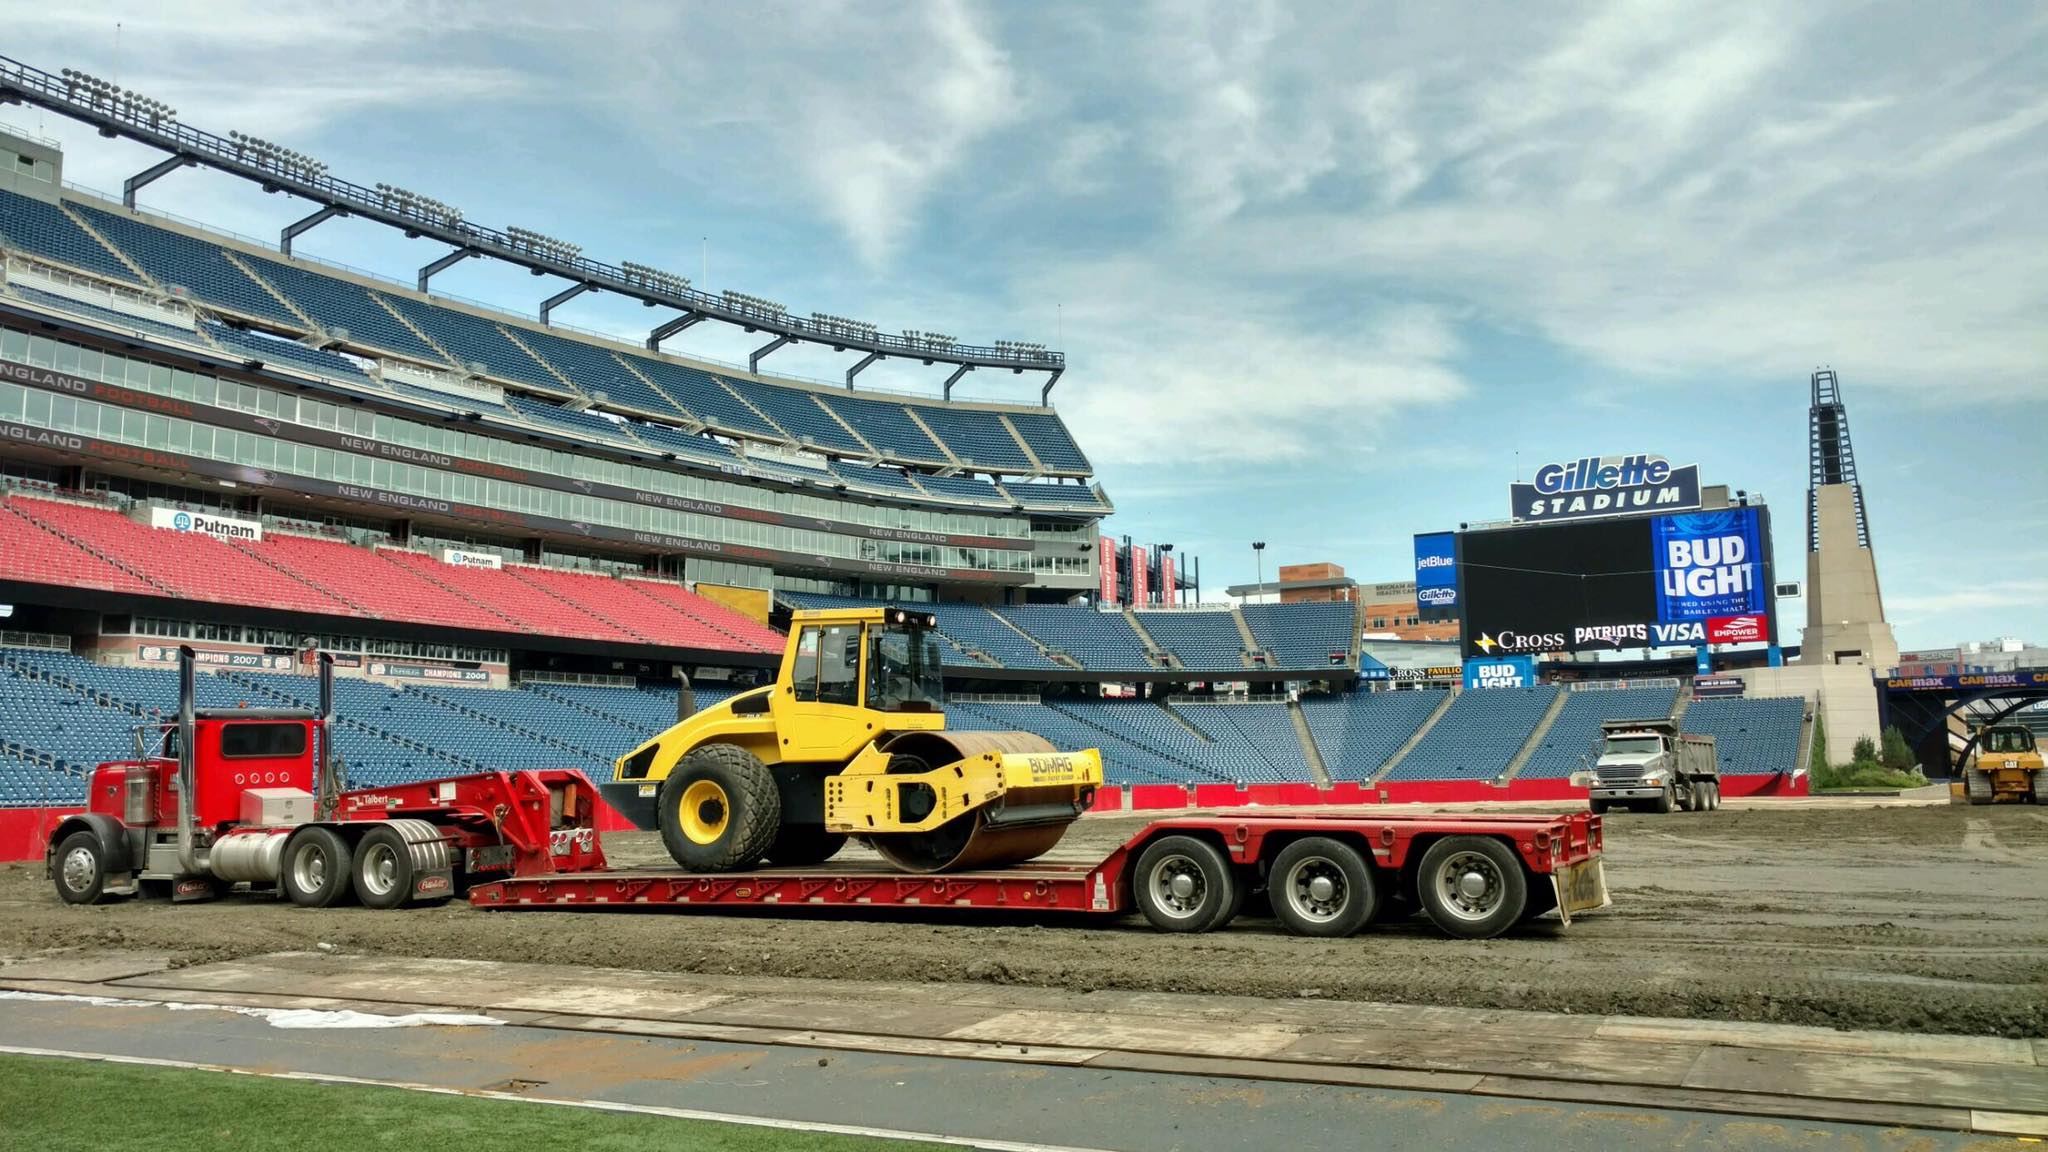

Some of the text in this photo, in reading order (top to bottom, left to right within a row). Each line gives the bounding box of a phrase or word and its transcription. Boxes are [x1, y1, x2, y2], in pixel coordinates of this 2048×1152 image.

[95, 384, 193, 416] FOOTBALL
[90, 442, 191, 468] FOOTBALL
[341, 437, 376, 451] NEW
[381, 445, 450, 466] ENGLAND
[1534, 454, 1672, 495] Gillette
[338, 485, 373, 499] NEW
[378, 492, 449, 512] ENGLAND
[636, 492, 722, 513] NEW ENGLAND
[1530, 487, 1680, 515] STADIUM
[194, 517, 254, 538] Putnam
[869, 528, 892, 537] NEW
[896, 532, 947, 542] ENGLAND
[635, 533, 721, 552] NEW ENGLAND
[1668, 535, 1746, 568] BUD
[462, 555, 493, 566] Putnam
[1417, 556, 1454, 570] jetBlue
[869, 563, 892, 573] NEW
[896, 566, 947, 577] ENGLAND
[1663, 562, 1753, 597] LIGHT
[1419, 588, 1456, 601] Gillette
[1701, 599, 1728, 607] USING
[1575, 624, 1648, 645] PATRIOTS
[1651, 622, 1706, 642] VISA
[1713, 628, 1758, 637] EMPOWER
[233, 655, 257, 665] 2007
[424, 668, 461, 679] CHAMPIONS
[1479, 664, 1515, 678] BUD
[1472, 676, 1523, 689] LIGHT
[1028, 757, 1073, 774] BOMAG
[363, 794, 388, 805] Talbert
